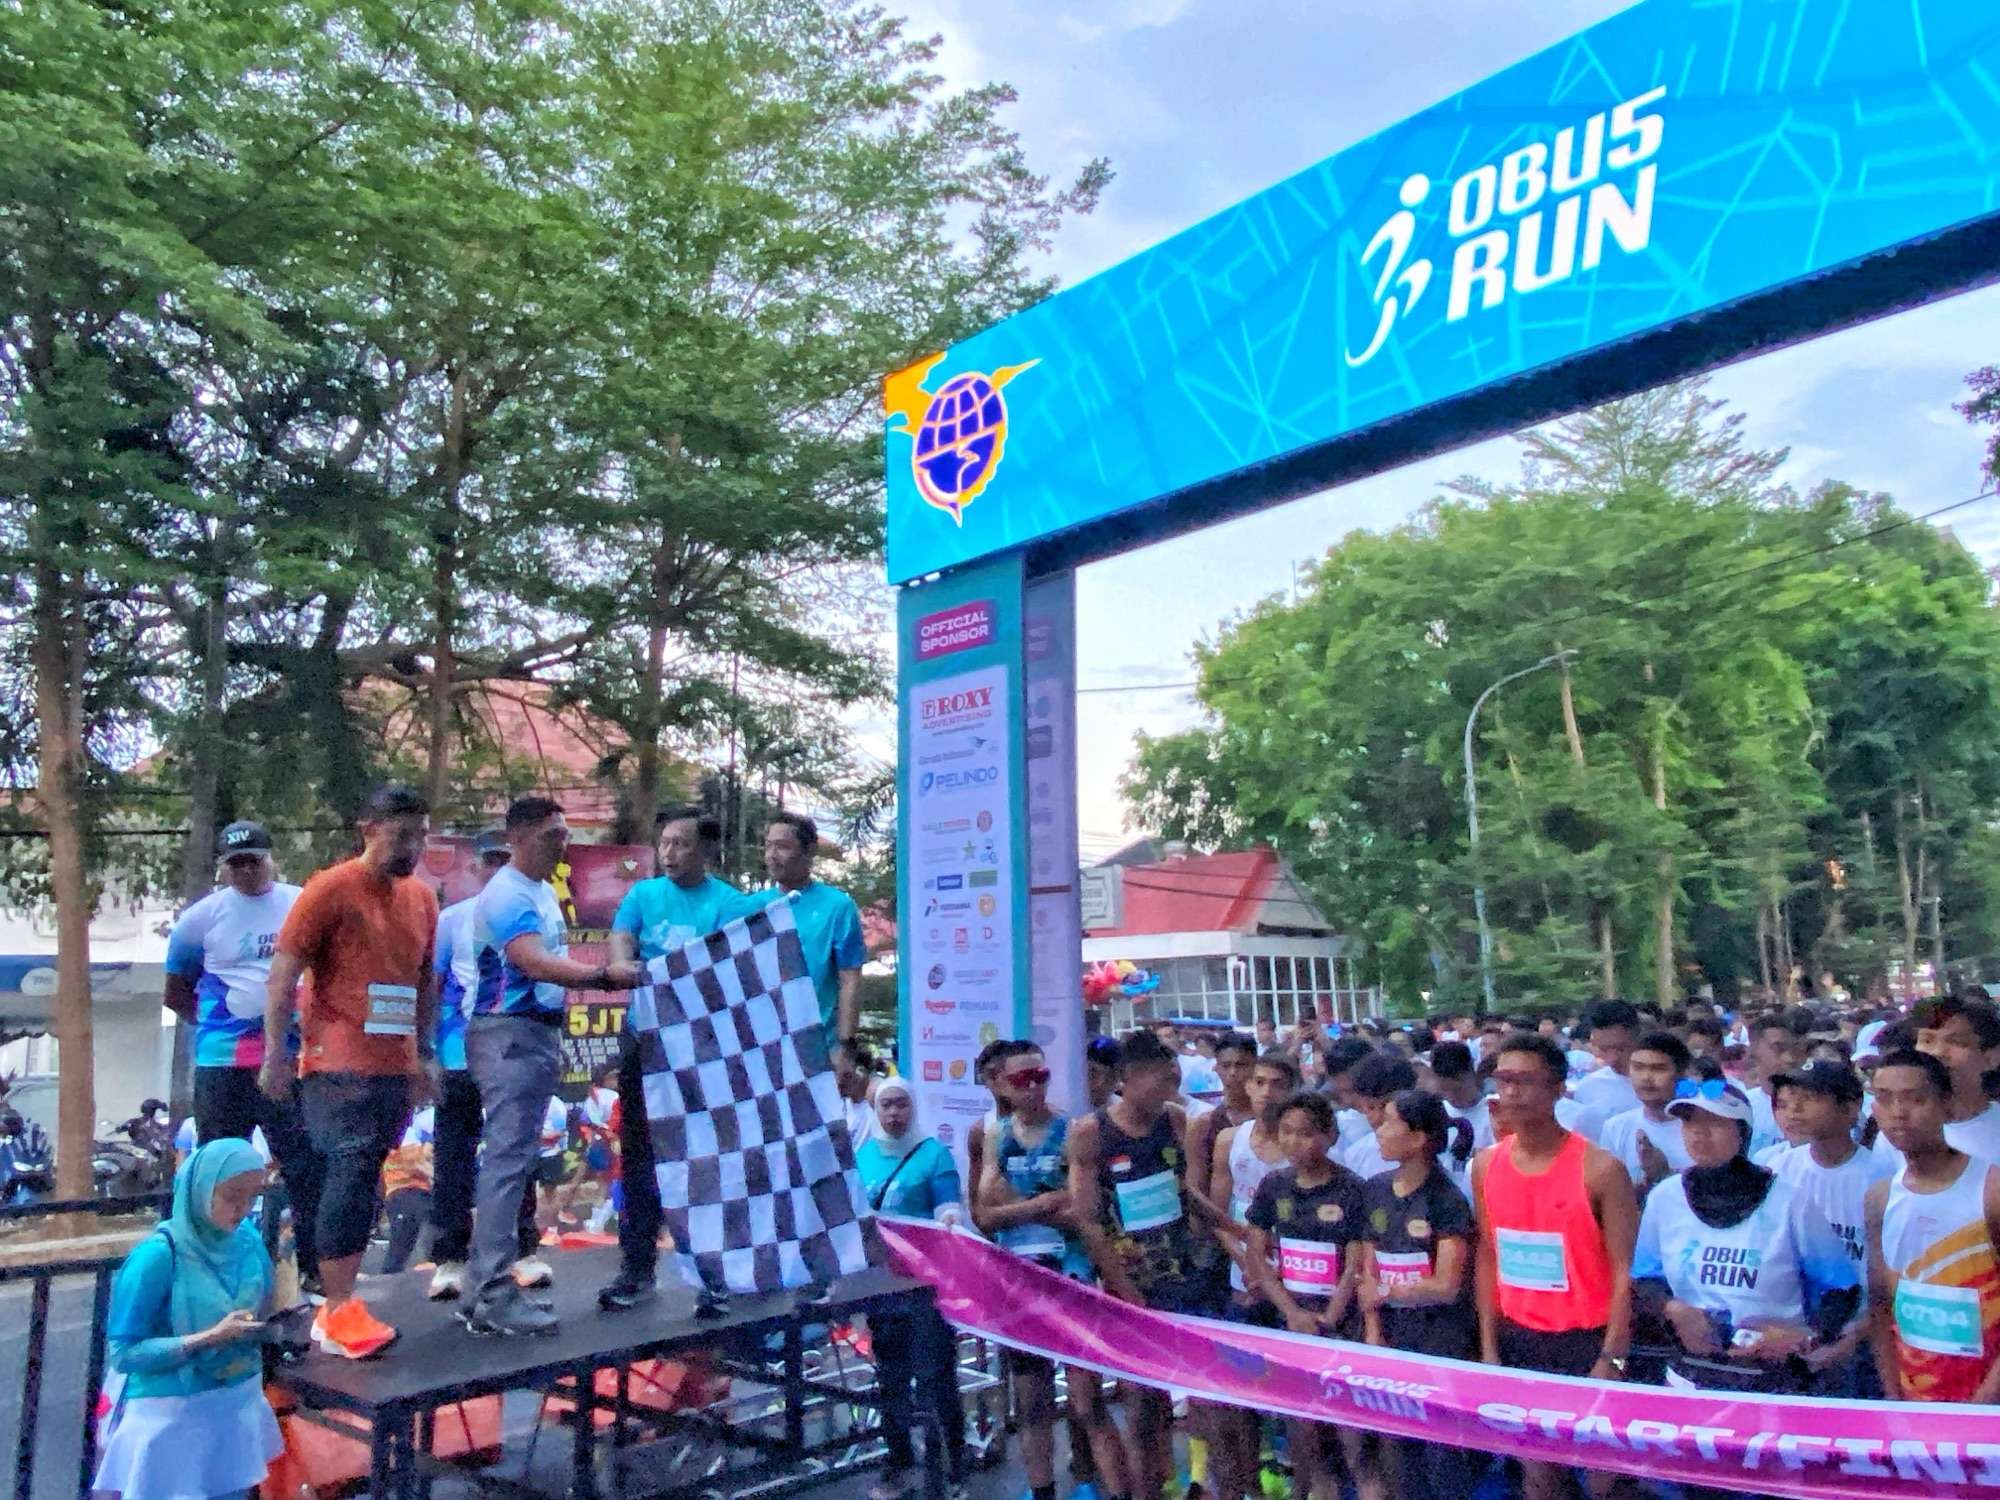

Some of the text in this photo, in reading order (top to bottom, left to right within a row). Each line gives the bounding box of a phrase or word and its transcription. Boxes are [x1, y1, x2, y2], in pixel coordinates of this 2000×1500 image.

[1446, 162, 1658, 324] RUN
[920, 610, 989, 637] OFFICIAL
[921, 624, 989, 652] SPONSOR
[937, 686, 993, 716] ROXY
[936, 766, 999, 789] PELINDO
[227, 830, 250, 845] XIV
[1283, 1255, 1329, 1274] 0318
[1700, 1263, 1759, 1290] RUN
